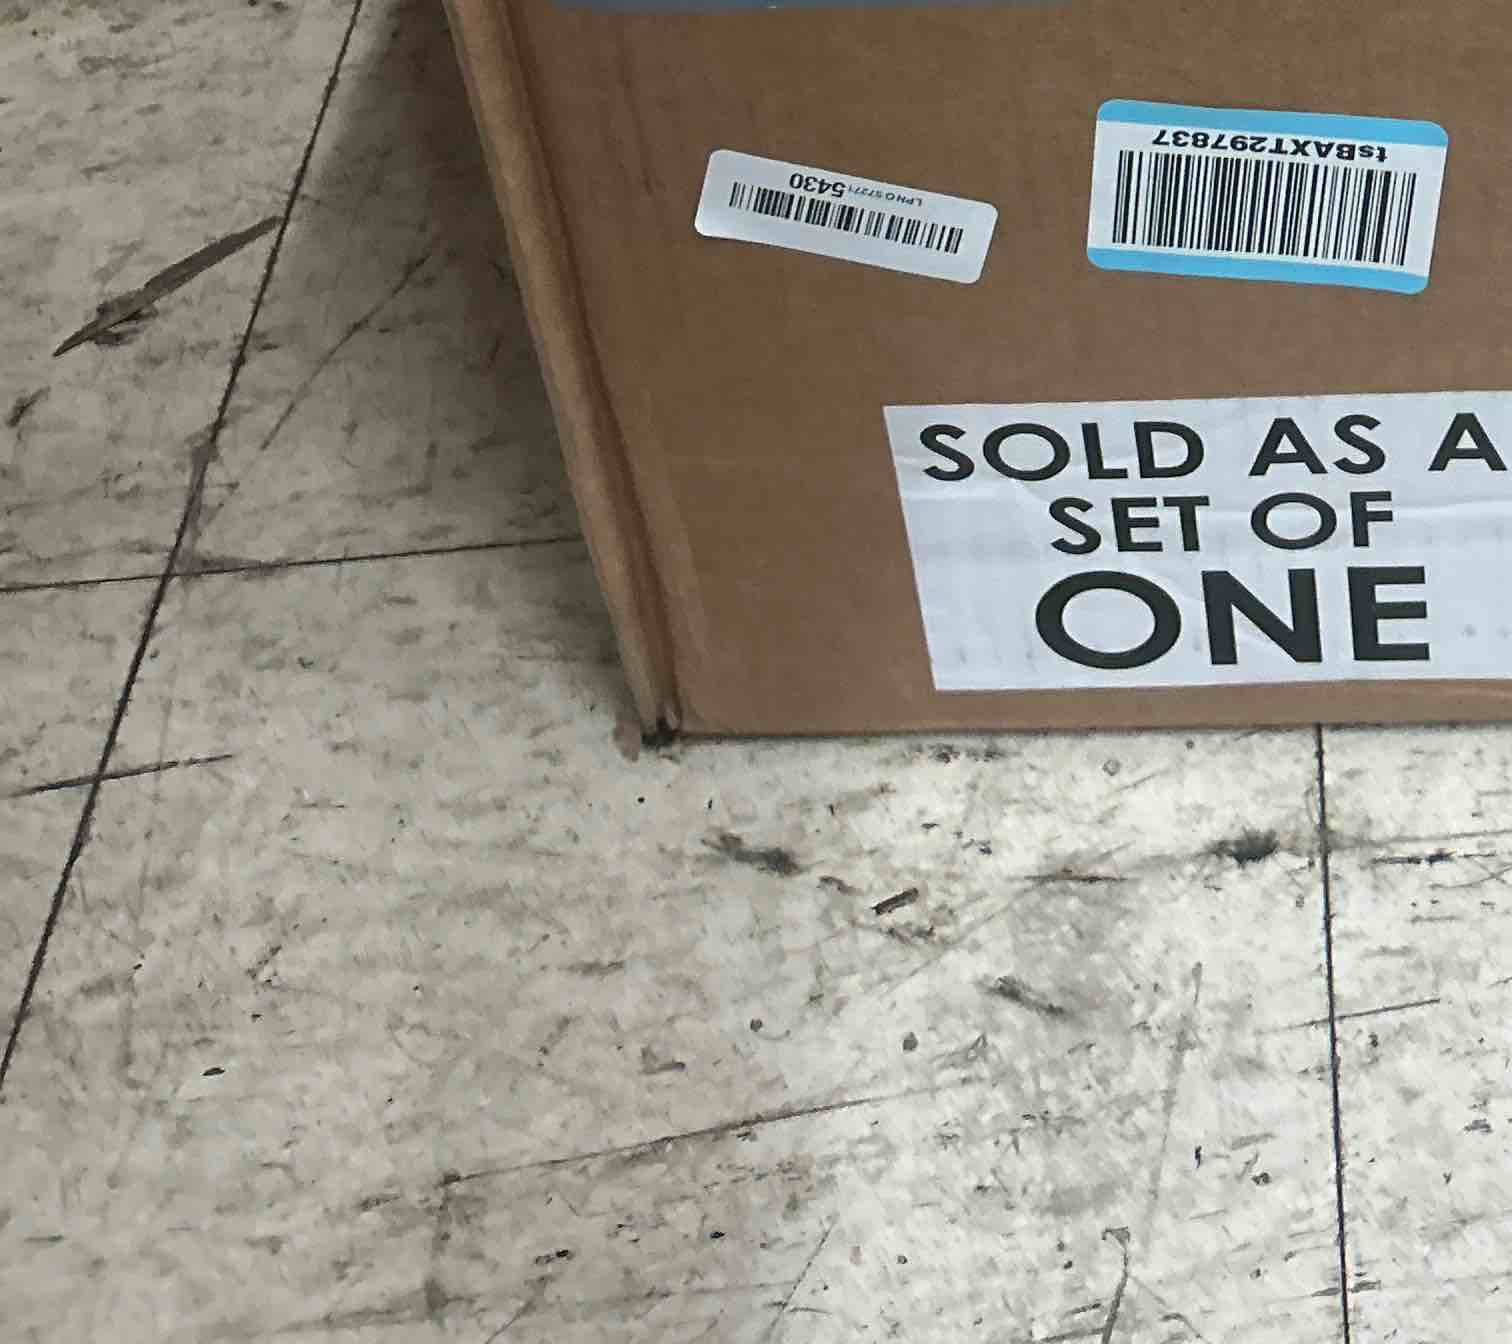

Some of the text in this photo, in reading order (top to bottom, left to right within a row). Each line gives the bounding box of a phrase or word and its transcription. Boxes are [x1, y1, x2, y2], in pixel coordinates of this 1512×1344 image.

[1152, 128, 1388, 162] tsBAXT297837
[789, 172, 846, 198] 5430
[919, 411, 1507, 481] SOLD AS A
[1048, 490, 1394, 555] SET OF
[1035, 565, 1431, 670] ONE
